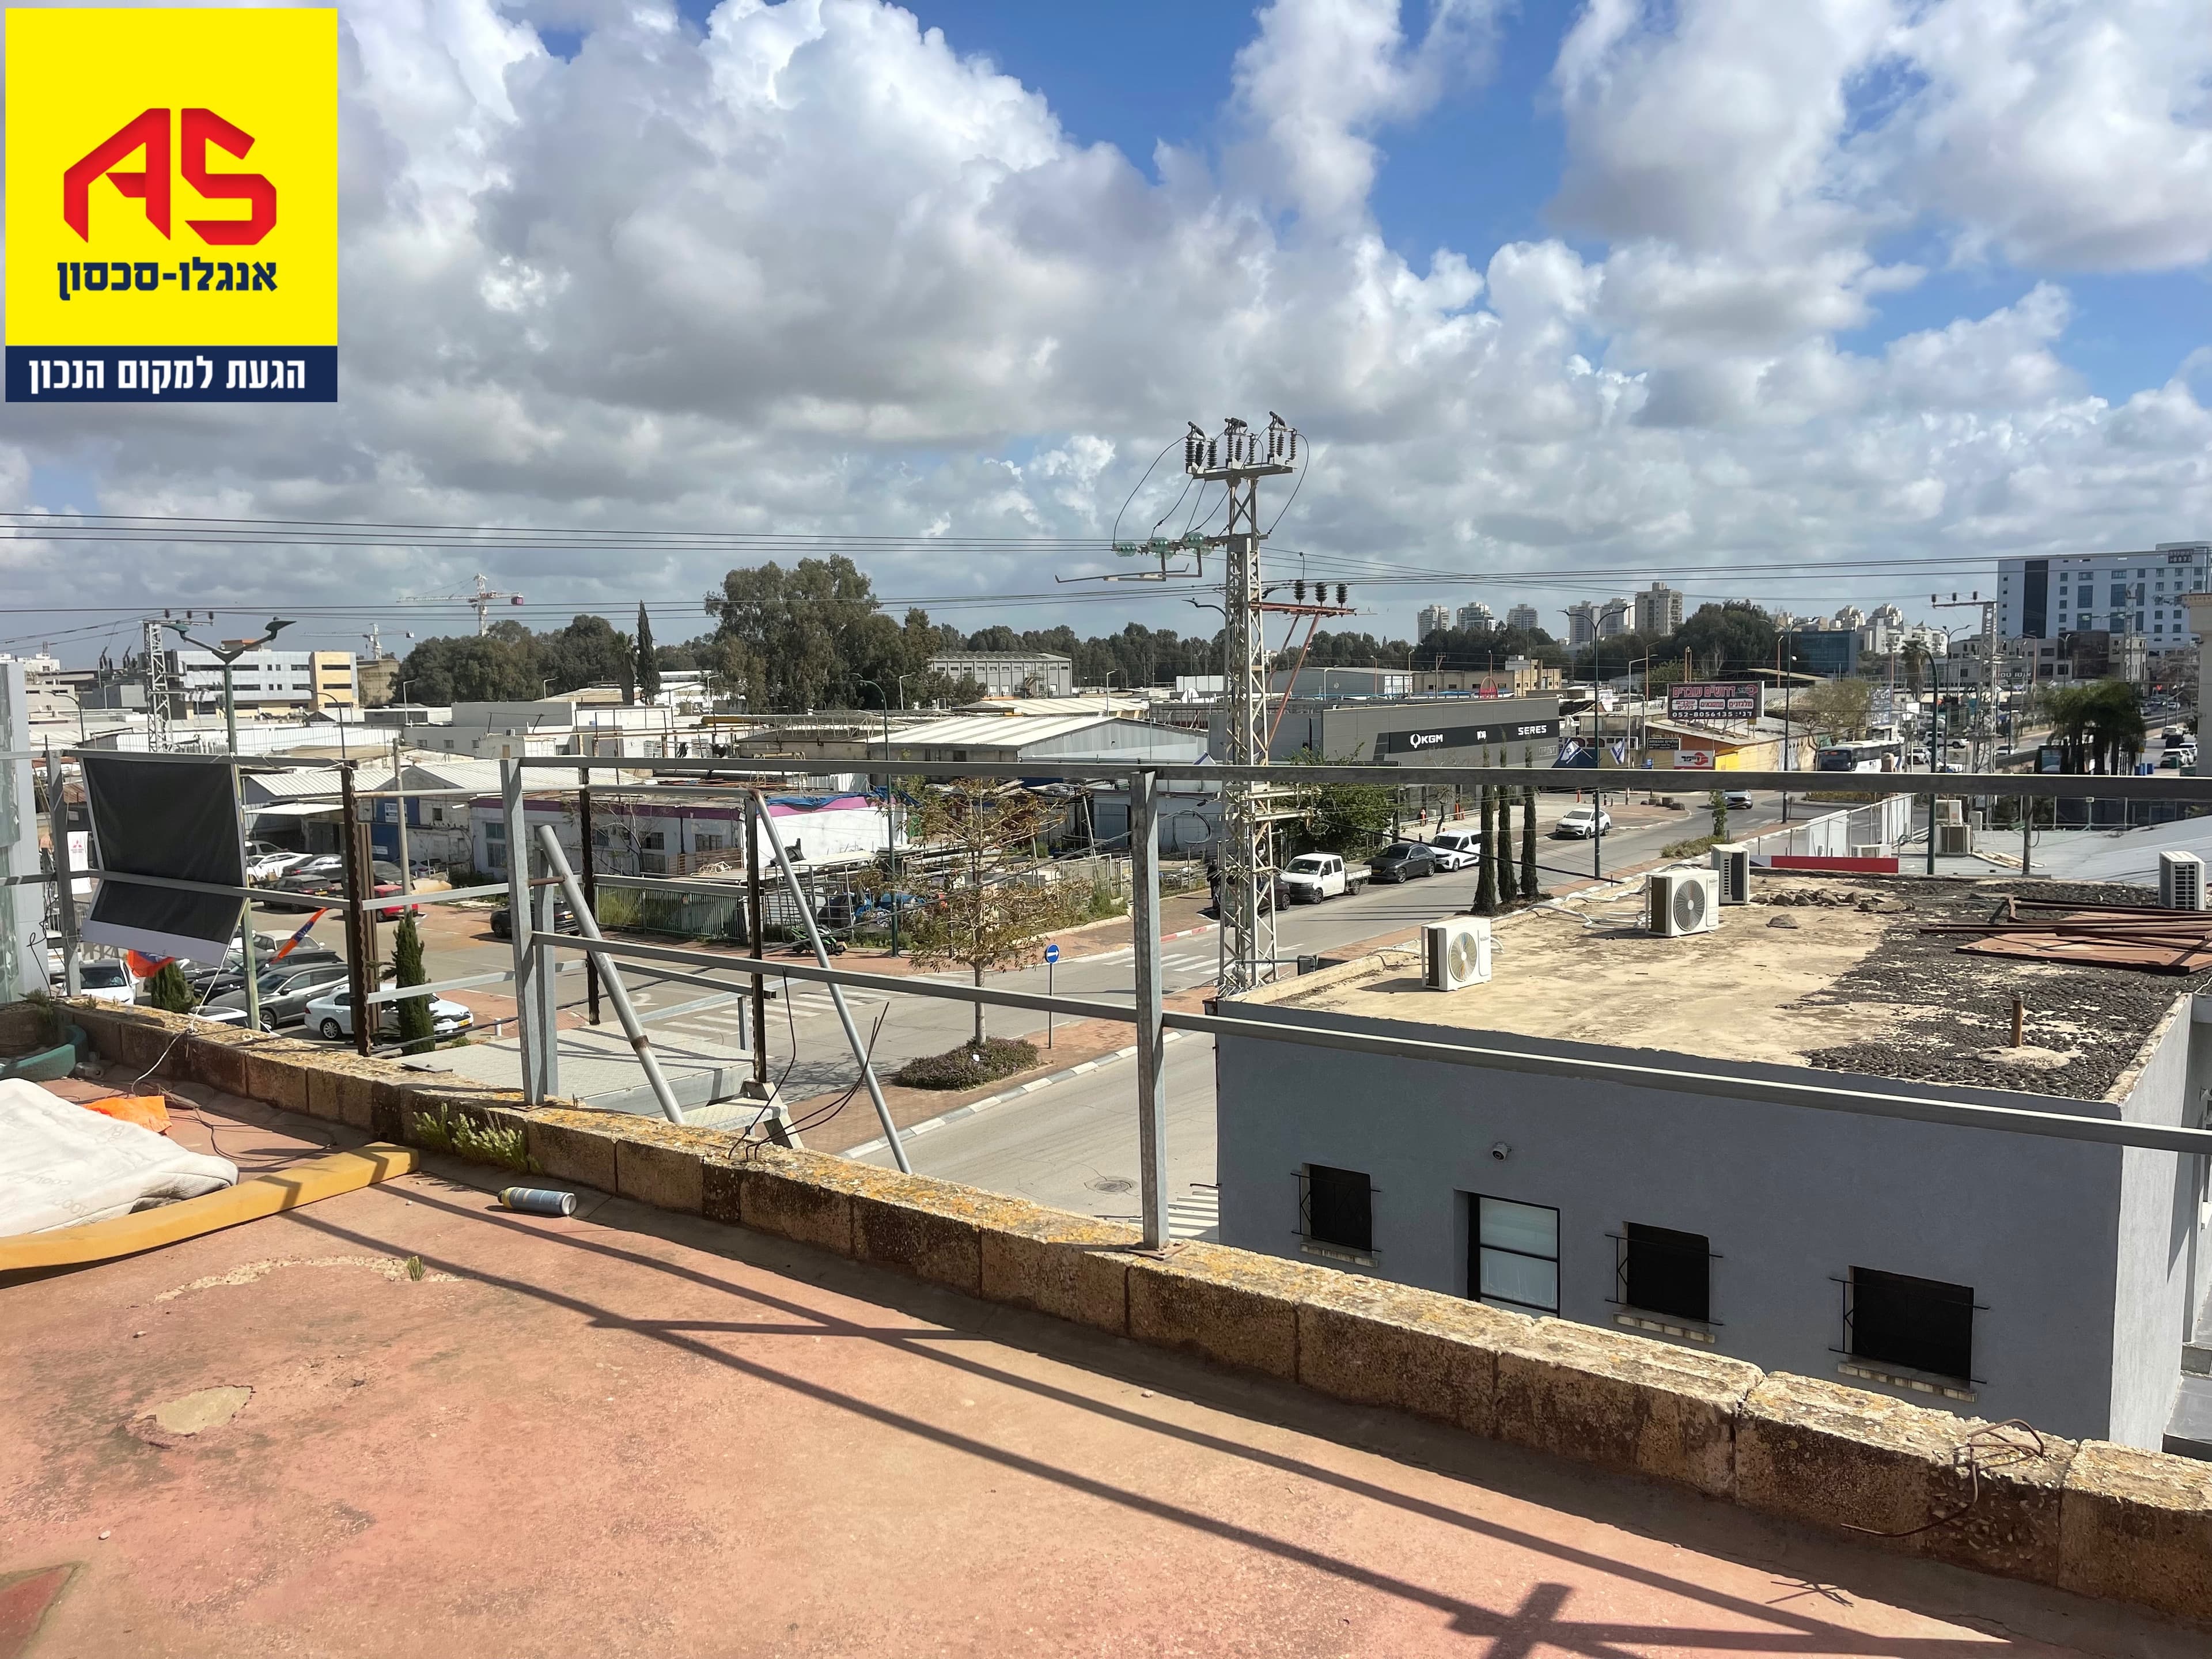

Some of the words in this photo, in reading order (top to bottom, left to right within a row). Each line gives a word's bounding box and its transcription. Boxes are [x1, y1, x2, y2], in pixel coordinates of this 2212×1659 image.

[1673, 687, 1703, 698] עובדים
[1705, 686, 1736, 697] דרושים
[1518, 725, 1547, 736] SERES
[1421, 734, 1444, 744] KGM
